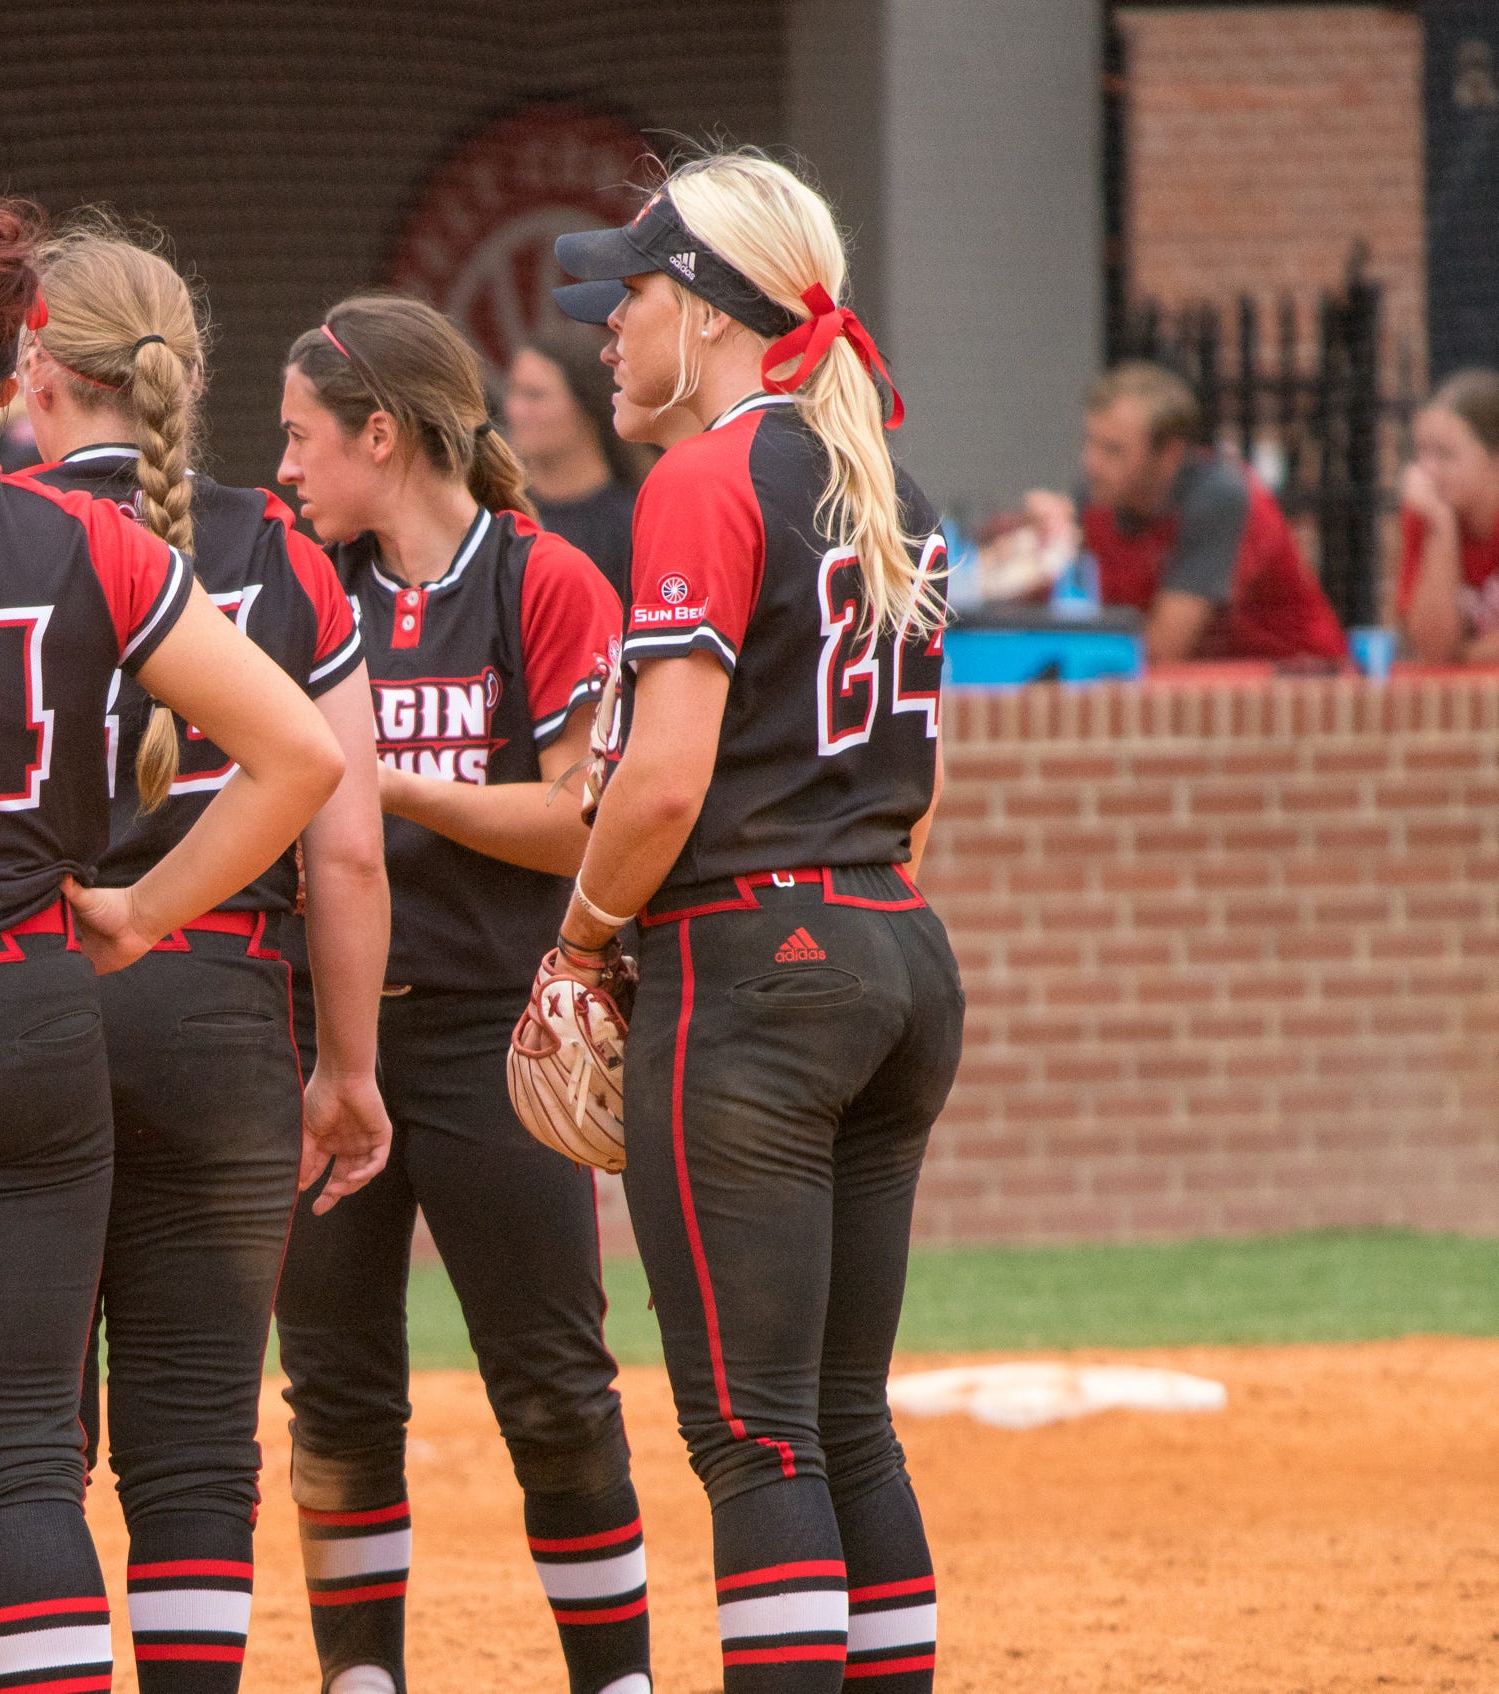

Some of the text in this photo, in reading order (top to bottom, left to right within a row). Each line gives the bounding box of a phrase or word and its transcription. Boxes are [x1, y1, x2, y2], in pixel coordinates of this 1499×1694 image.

[669, 255, 695, 281] adidas
[817, 534, 948, 756] 24
[774, 947, 826, 963] adidas
